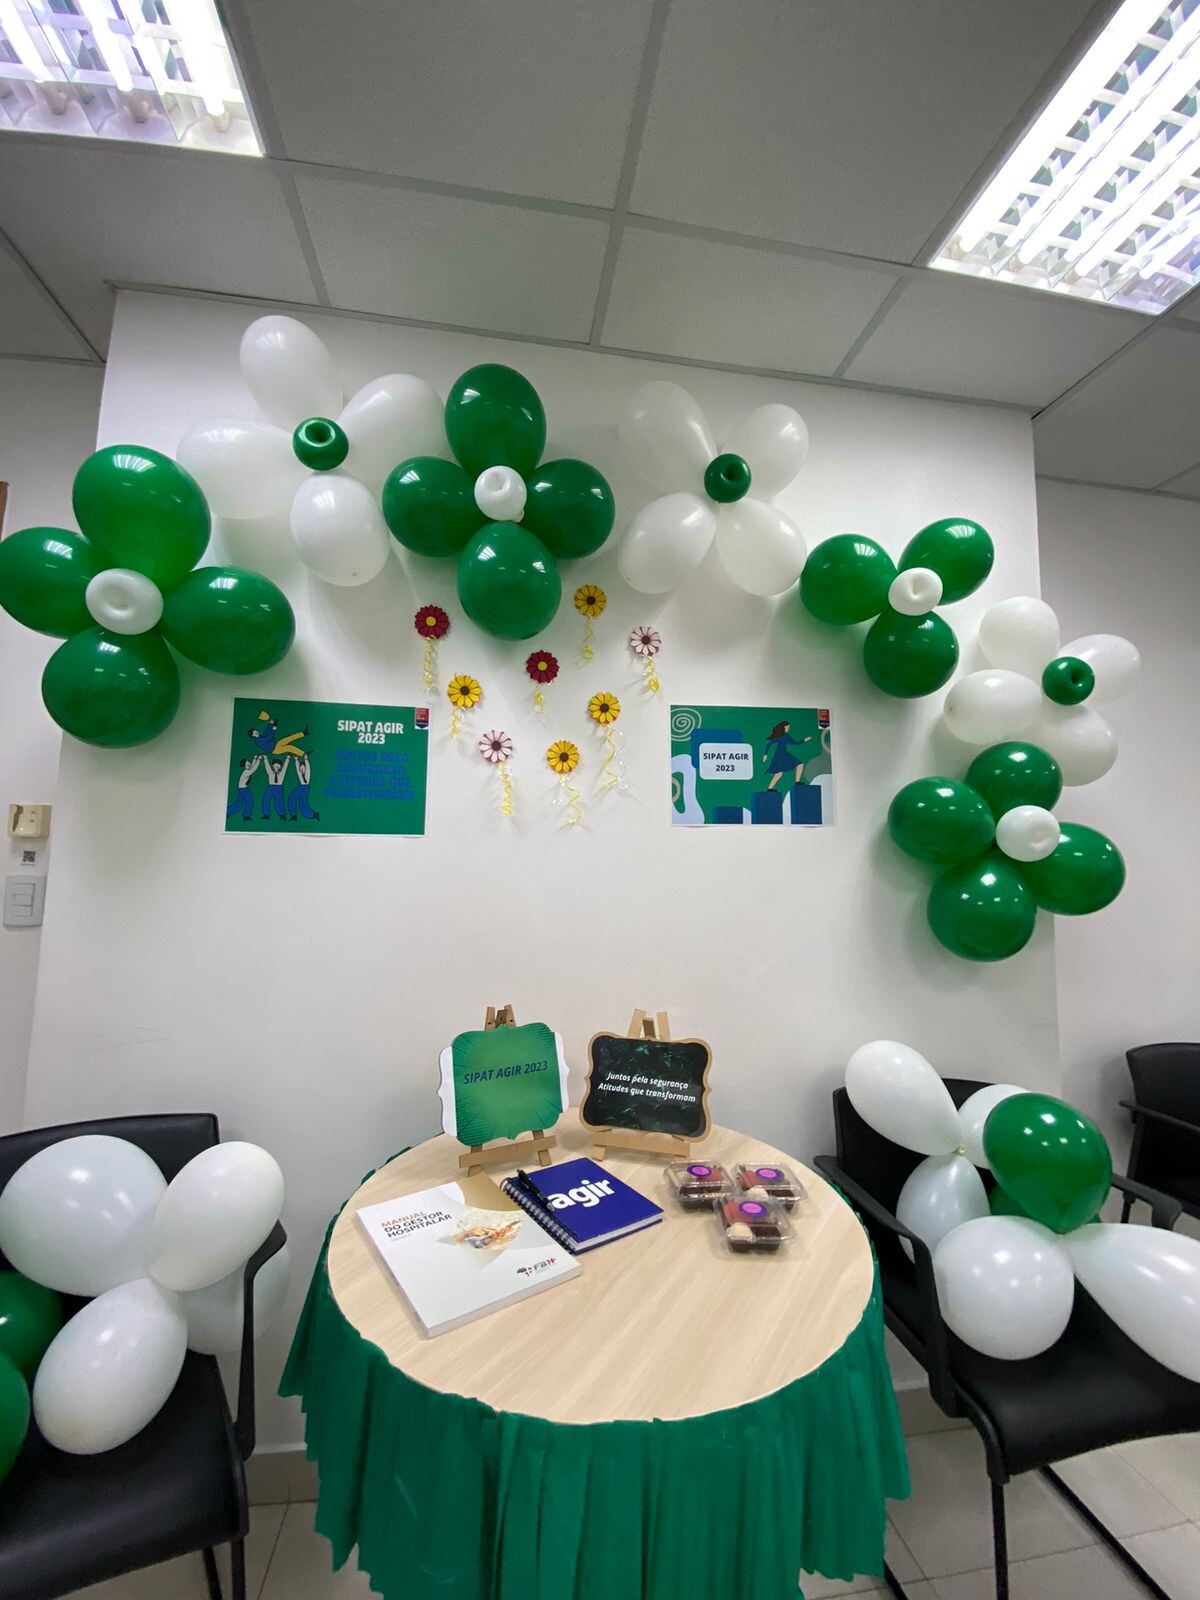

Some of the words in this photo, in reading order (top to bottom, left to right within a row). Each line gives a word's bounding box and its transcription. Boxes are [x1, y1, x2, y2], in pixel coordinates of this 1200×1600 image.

[337, 720, 373, 732] SIPAT
[375, 722, 404, 734] AGIR
[357, 732, 386, 745] 2023
[703, 752, 727, 761] SIPAT
[728, 753, 749, 761] AGIR
[715, 764, 736, 772] 2023
[463, 1069, 494, 1085] SIPAT
[496, 1065, 522, 1079] AGIR
[524, 1060, 549, 1074] 2023
[606, 1072, 631, 1081] Juntos
[631, 1076, 648, 1084] pela
[649, 1078, 689, 1091] segurança
[597, 1082, 629, 1093] Atitudes
[630, 1087, 645, 1096] que
[645, 1089, 696, 1102] transformam
[547, 1179, 616, 1209] agir
[381, 1211, 426, 1228] MANUAL
[384, 1224, 401, 1233] DO
[403, 1211, 444, 1228] GESTOR
[387, 1214, 453, 1238] HOSPITALAR
